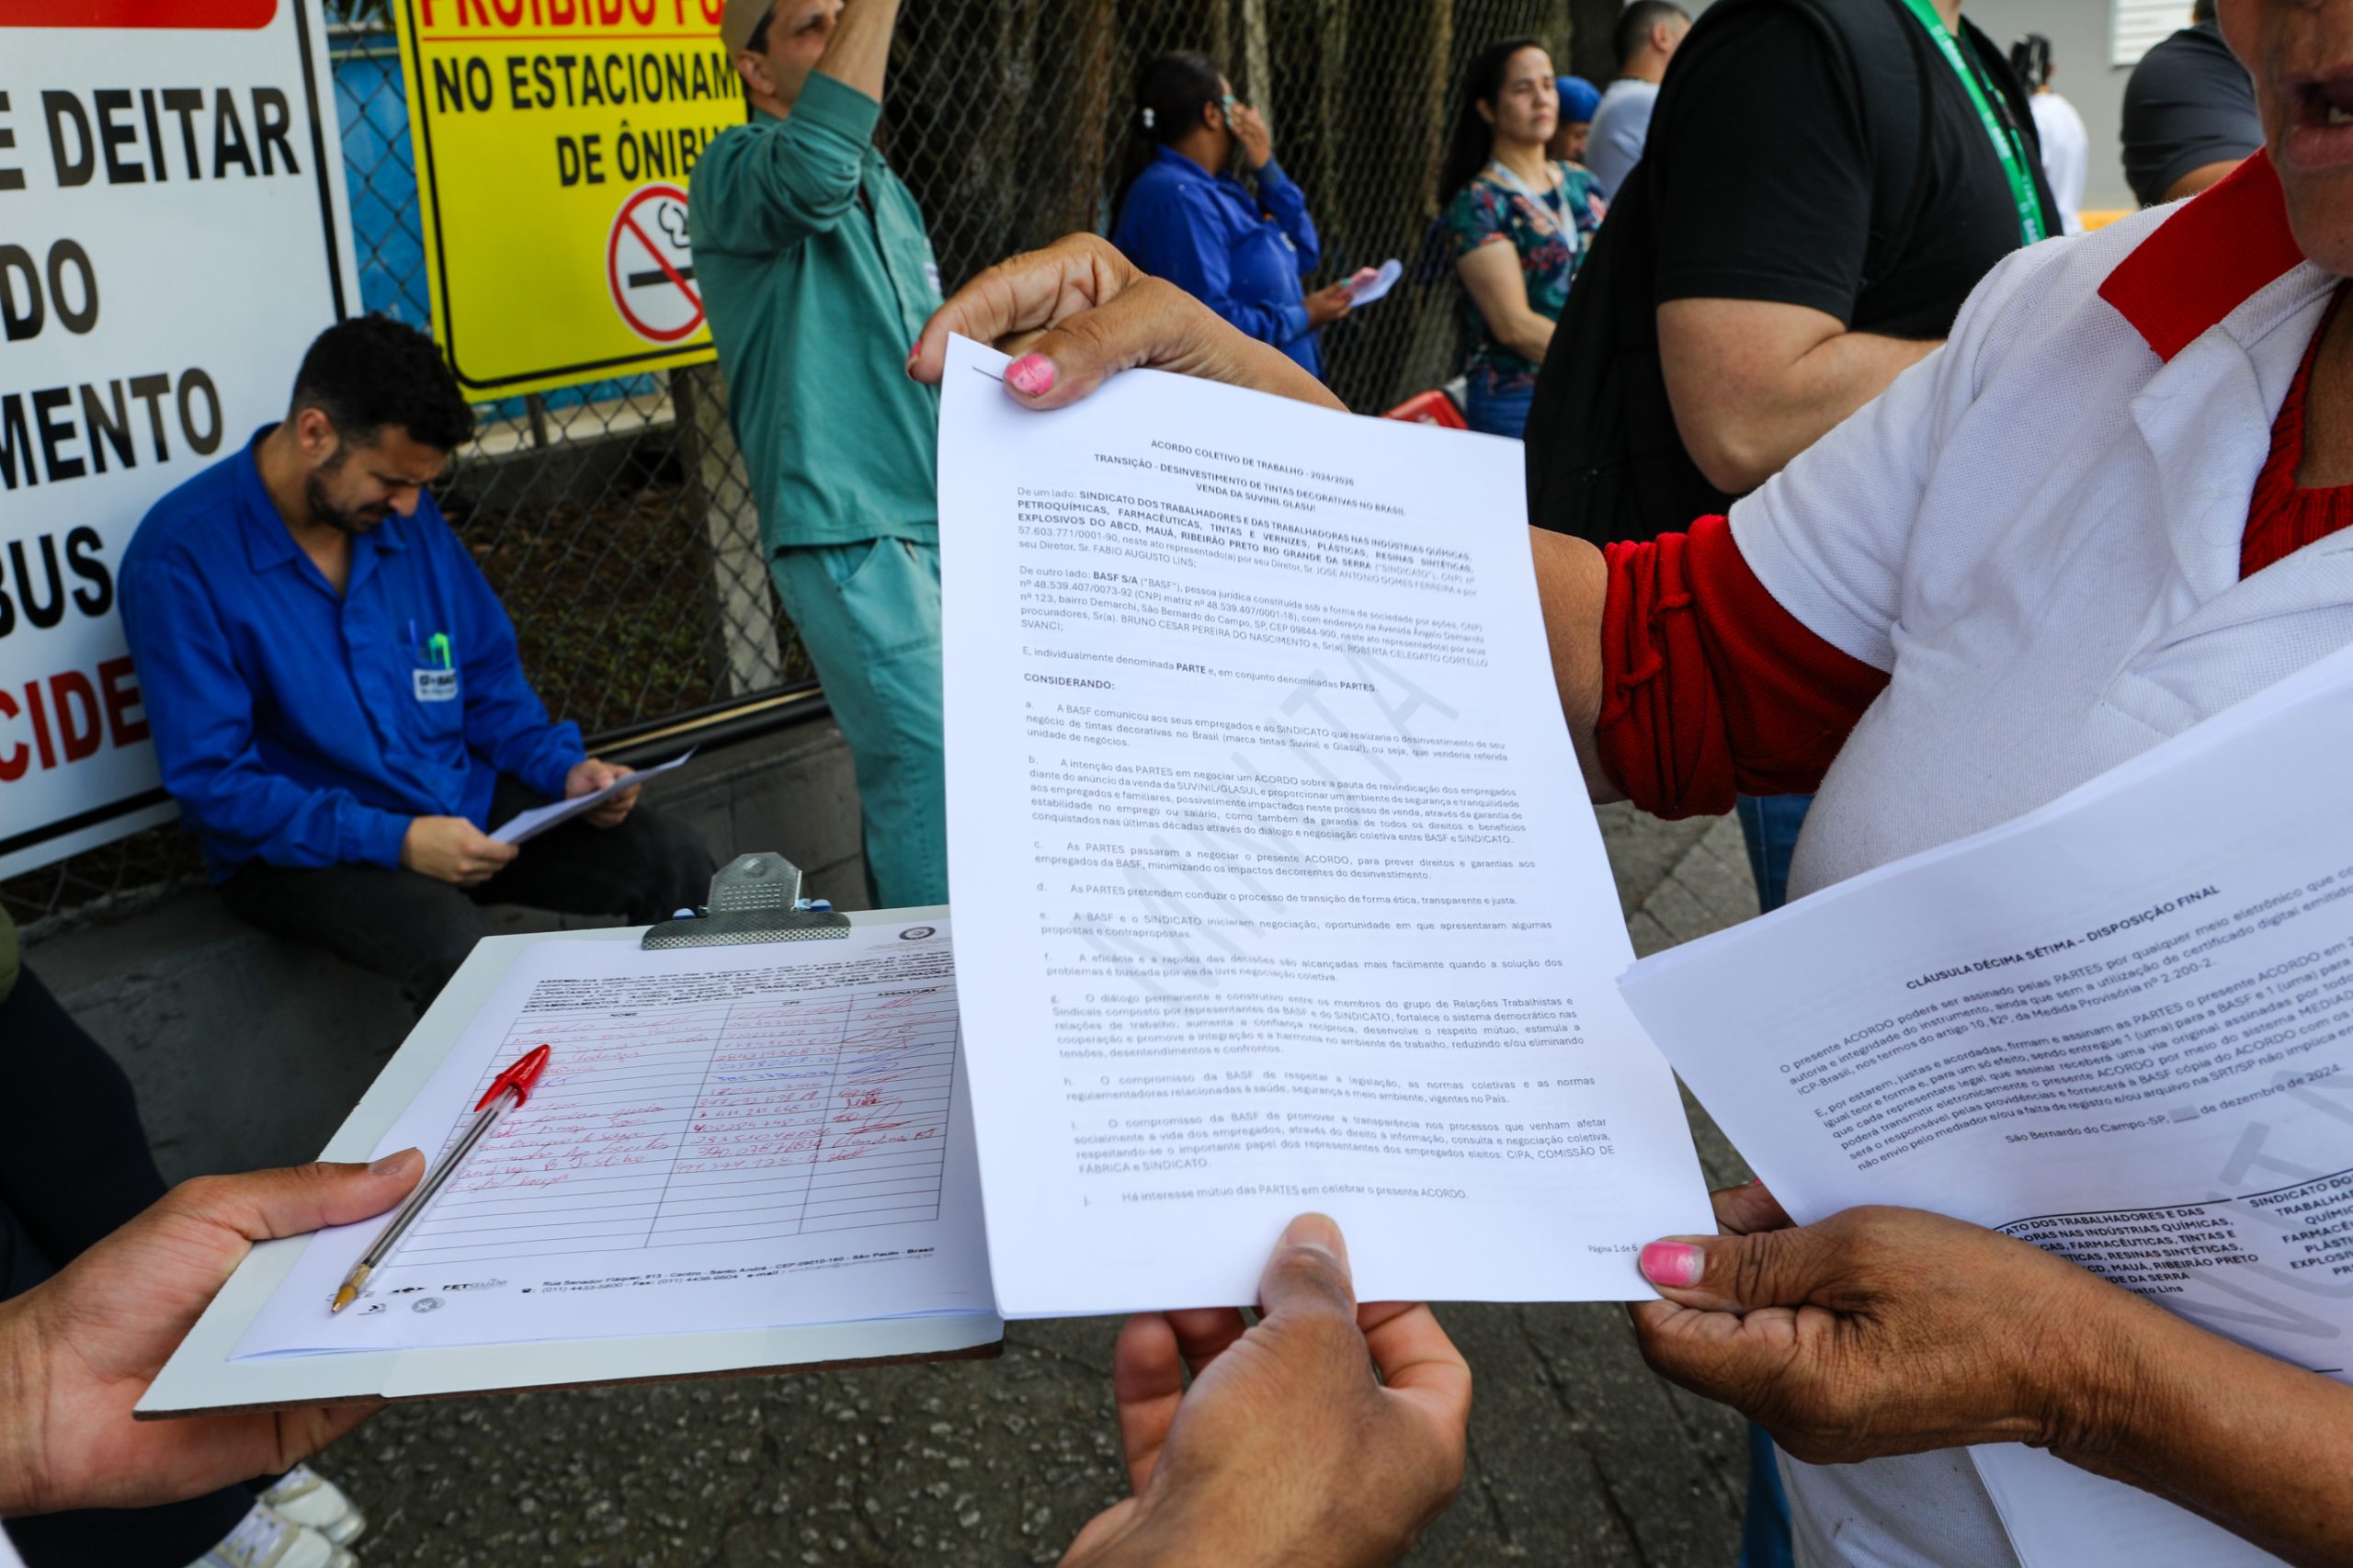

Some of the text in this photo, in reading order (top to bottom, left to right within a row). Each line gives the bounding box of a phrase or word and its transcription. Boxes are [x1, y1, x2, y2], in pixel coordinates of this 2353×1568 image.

[432, 56, 493, 113] NO
[41, 86, 301, 188] DEITAR
[556, 134, 606, 187] DE
[0, 238, 99, 342] DO
[0, 367, 223, 491] MENTO
[1150, 438, 1193, 455] ACORDO
[1194, 448, 1241, 464] COLETIVO
[1241, 456, 1255, 467] DE
[1256, 460, 1304, 476] TRABALHO
[1094, 453, 1153, 470] TRANSIÇÃO
[1159, 462, 1248, 487] DESINVESTIMENTO
[1248, 480, 1261, 490] DE
[1264, 483, 1295, 496] TINTAS
[1295, 488, 1358, 508] DECORATIVAS
[1358, 500, 1373, 511] NO
[1195, 483, 1229, 496] VENDA
[1229, 488, 1244, 499] DA
[1245, 492, 1281, 506] SUVINIL
[1017, 486, 1031, 496] De
[1032, 489, 1051, 497] um
[1051, 488, 1074, 498] lado:
[1078, 490, 1135, 506] SINDICATO
[1136, 497, 1159, 509] DOS
[1159, 501, 1242, 524] TRABALHADORES
[1243, 516, 1249, 525] E
[1250, 517, 1270, 528] DAS
[1271, 521, 1349, 542] TRABALHADORAS
[1350, 534, 1370, 546] NAS
[1017, 499, 1109, 516] PETROQUÍMICAS,
[1118, 507, 1203, 531] FARMACÊUTICAS,
[1210, 522, 1243, 537] TINTAS
[1248, 529, 1255, 539] E
[1262, 532, 1310, 550] VERNIZES,
[1316, 540, 1369, 558] PLÁSTICAS,
[1374, 550, 1415, 565] RESINAS
[1021, 645, 1378, 693] E, individualmente denominada PARTE e, em conjunto denominadas PARTES.
[1023, 672, 1115, 690] CONSIDERANDO:
[1026, 728, 1130, 747] unidade de negócios.
[1036, 882, 1518, 907] d. As PARTES pretendem conduzir o processo de transição de forma ética, transparente e justa.
[1905, 964, 1973, 990] CLÁUSULA
[1972, 953, 2025, 971] DÉCIMA
[2024, 938, 2076, 960] SÉTIMA
[2086, 902, 2176, 942] DISPOSIÇÃO
[2176, 884, 2220, 908] FINAL
[1779, 875, 2335, 1074] O presente ACORDO poderá ser assinado pelas PARTES por qualquer meio eletrônico que
[877, 987, 937, 997] ASSINATURA
[2200, 1062, 2345, 1115] de dezembro de 2024.
[2004, 1114, 2170, 1143] São Bernardo do Campo-SP,
[2249, 1176, 2353, 1208] SINDICATO DO
[2274, 1188, 2353, 1217] TRABALHA
[2029, 1207, 2205, 1229] DOS TRABALHADORES E DAS
[2059, 1217, 2234, 1239] NAS INDÚSTRIAS QUÍMICAS,
[2281, 1220, 2353, 1244] FARMACÊ
[1587, 1244, 1613, 1254] Página
[2069, 1229, 2236, 1250] FARMACÊUTICAS, TINTAS E
[2107, 1242, 2244, 1260] RESINAS SINTÉTICAS,
[2110, 1253, 2259, 1272] MAUÁ, RIBEIRÃO PRETO
[2132, 1271, 2190, 1284] DA SERRA
[2157, 1285, 2184, 1295] Lins
